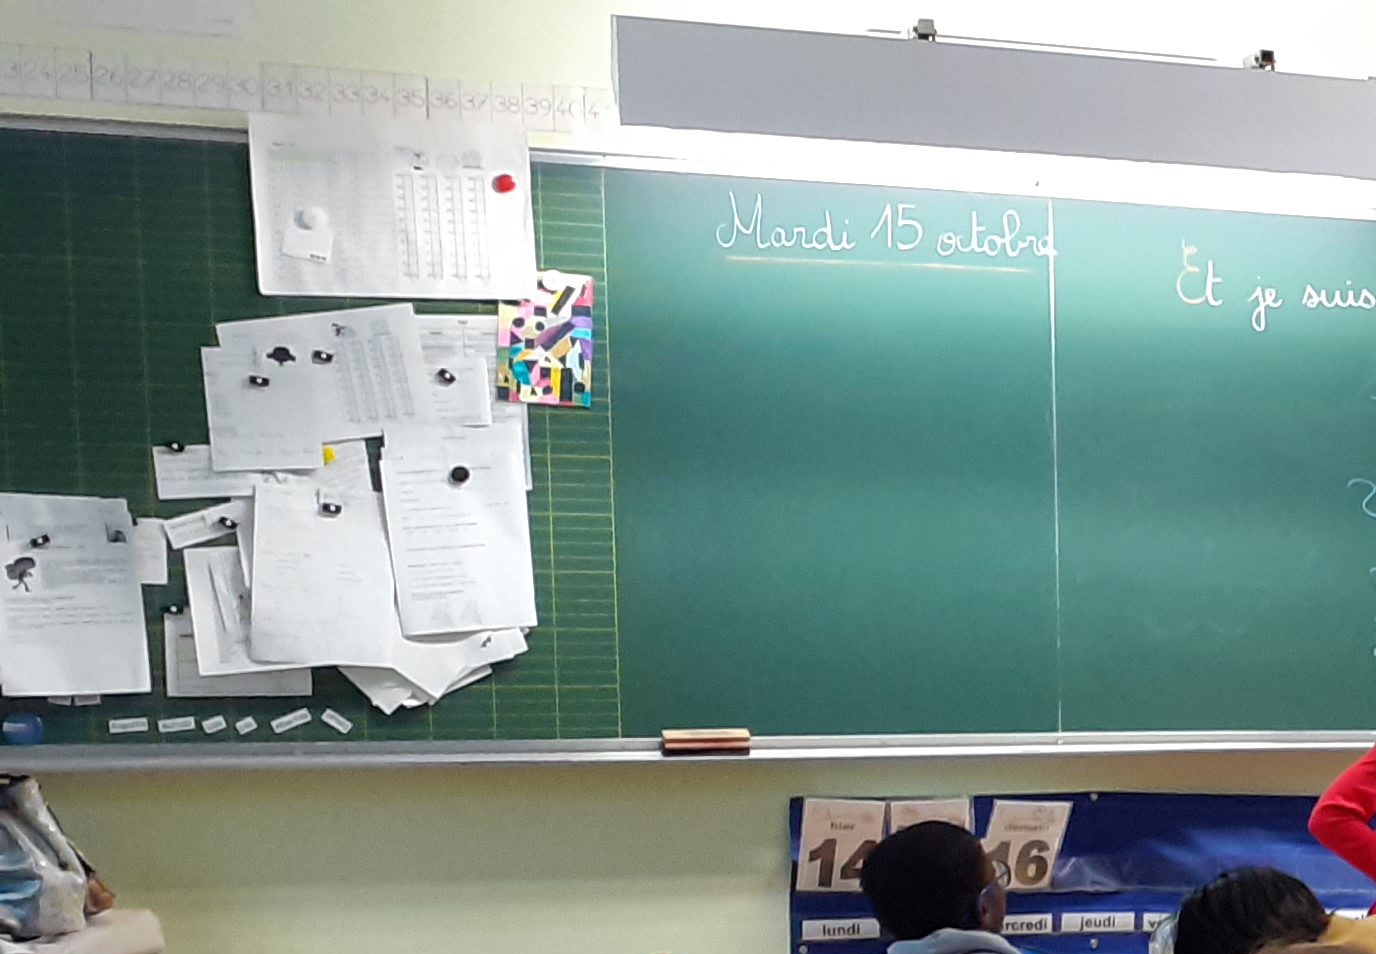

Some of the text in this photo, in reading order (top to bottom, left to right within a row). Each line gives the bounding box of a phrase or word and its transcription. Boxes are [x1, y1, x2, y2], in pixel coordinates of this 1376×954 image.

[716, 191, 856, 250] Mardi
[871, 204, 923, 251] 15
[1177, 239, 1223, 306] Et
[1248, 276, 1283, 332] je
[1302, 280, 1376, 309] suis
[822, 923, 861, 937] lundi
[1003, 915, 1048, 931] rcredi
[1080, 915, 1117, 932] jeudi
